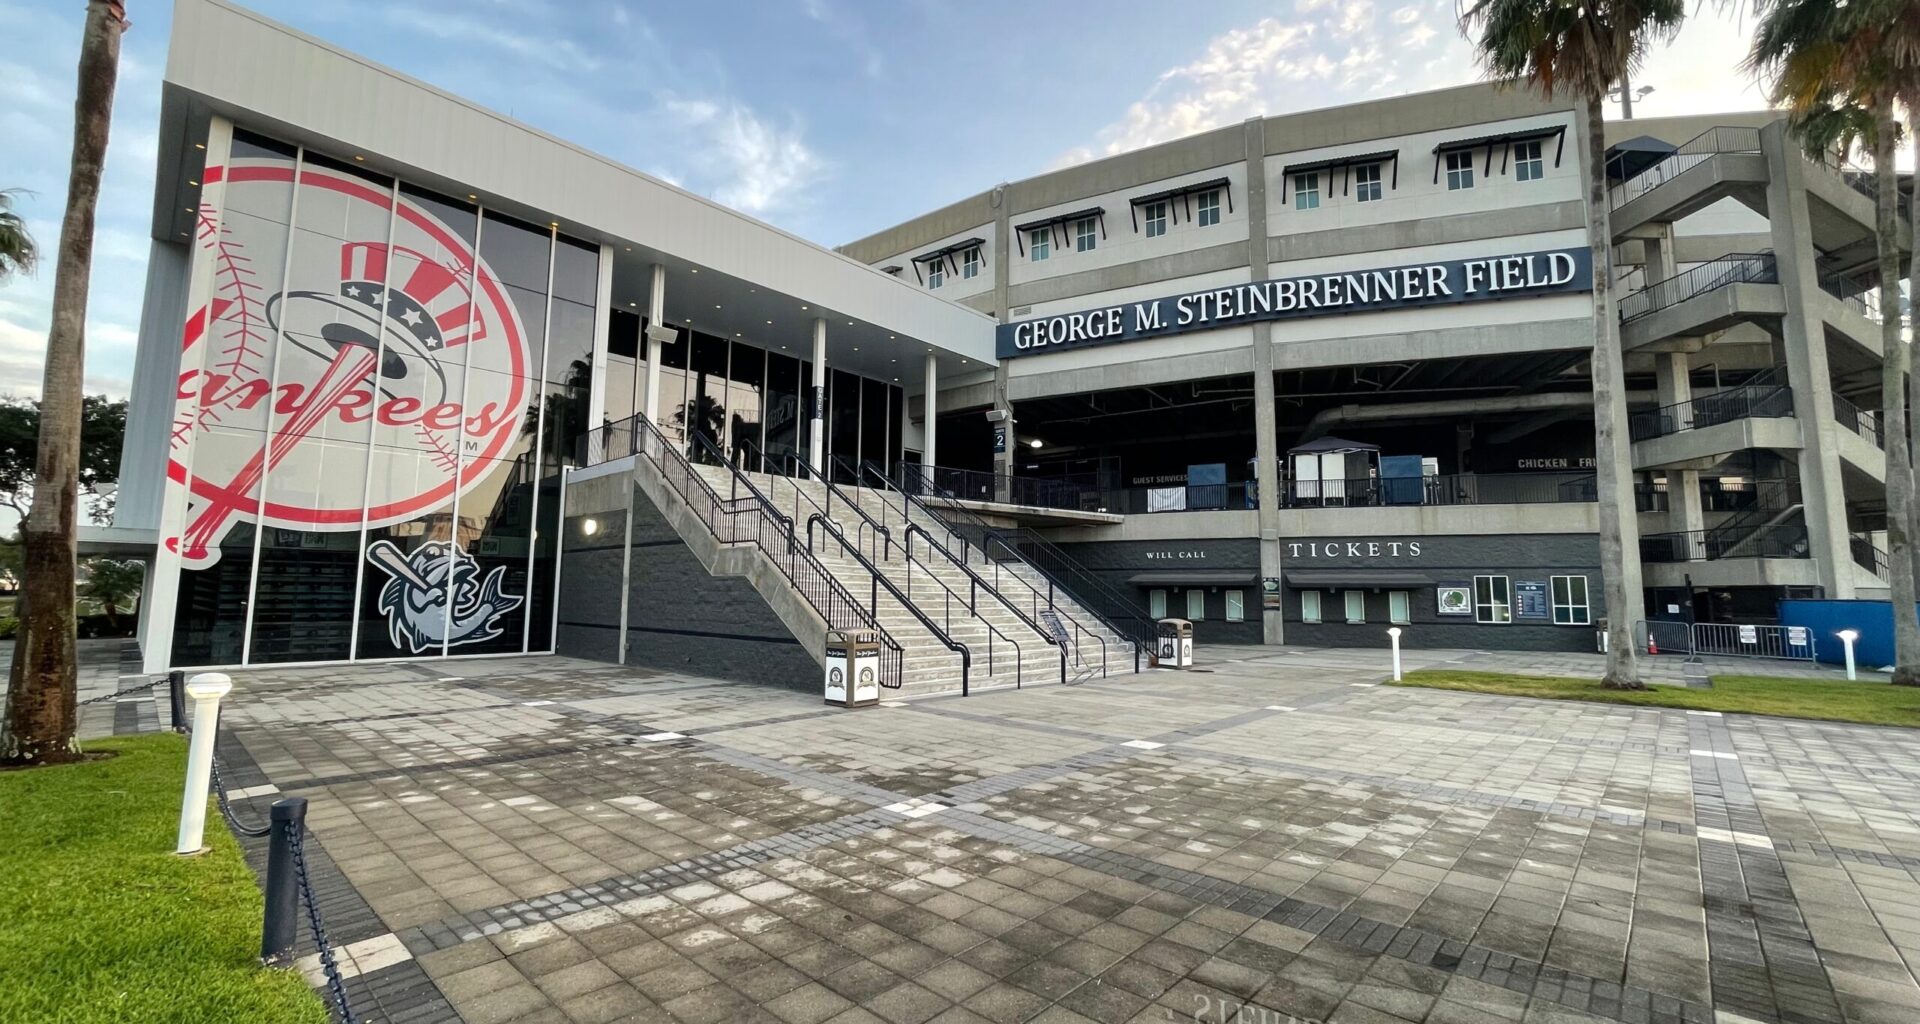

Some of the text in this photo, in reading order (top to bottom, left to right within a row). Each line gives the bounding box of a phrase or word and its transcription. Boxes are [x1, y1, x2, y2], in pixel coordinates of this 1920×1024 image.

[1014, 252, 1576, 350] GEORGE M. STEINBRENNER FIELD
[177, 362, 505, 437] ankees
[996, 435, 1004, 446] 2
[1518, 457, 1597, 469] CHICKEN FRI
[1132, 474, 1189, 484] GUEST SERVICES
[1146, 551, 1207, 560] WILL CALL
[1289, 541, 1422, 558] TICKETS
